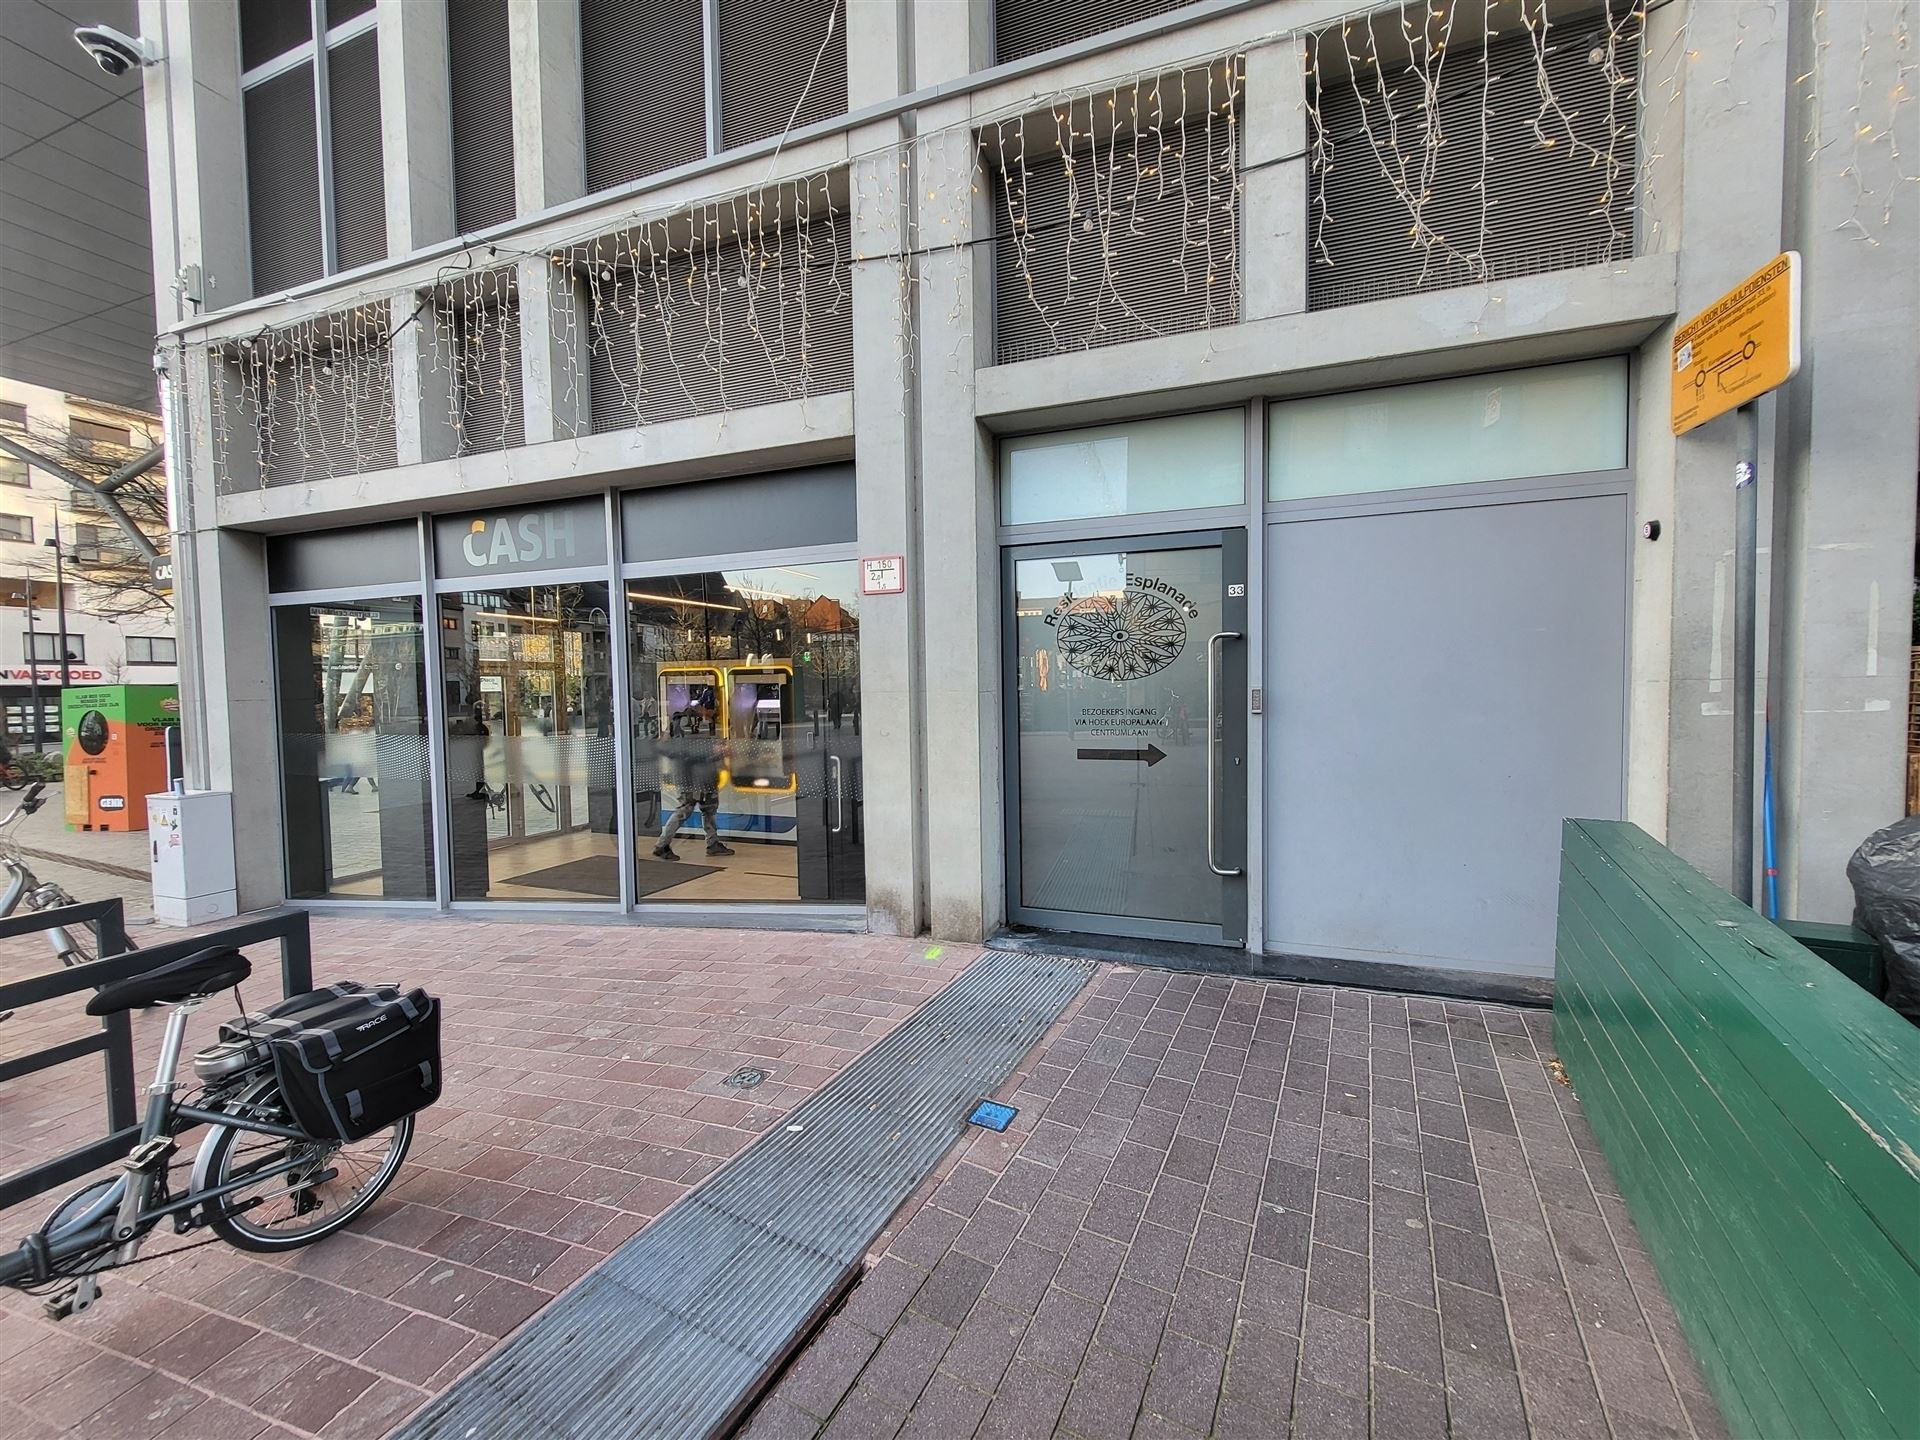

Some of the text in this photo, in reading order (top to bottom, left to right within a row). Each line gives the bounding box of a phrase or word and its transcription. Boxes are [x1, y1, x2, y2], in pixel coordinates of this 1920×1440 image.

[1701, 307, 1719, 326] VOOR
[1720, 299, 1730, 314] DE
[1730, 257, 1788, 307] HULPDIENSTEN
[462, 510, 576, 567] CASH
[866, 562, 873, 570] H
[1126, 573, 1199, 619] Esplanade
[1229, 586, 1244, 596] 33
[1082, 708, 1157, 716] BEZOEKERS INGANG
[1090, 728, 1149, 736] CENTRUMLAAN
